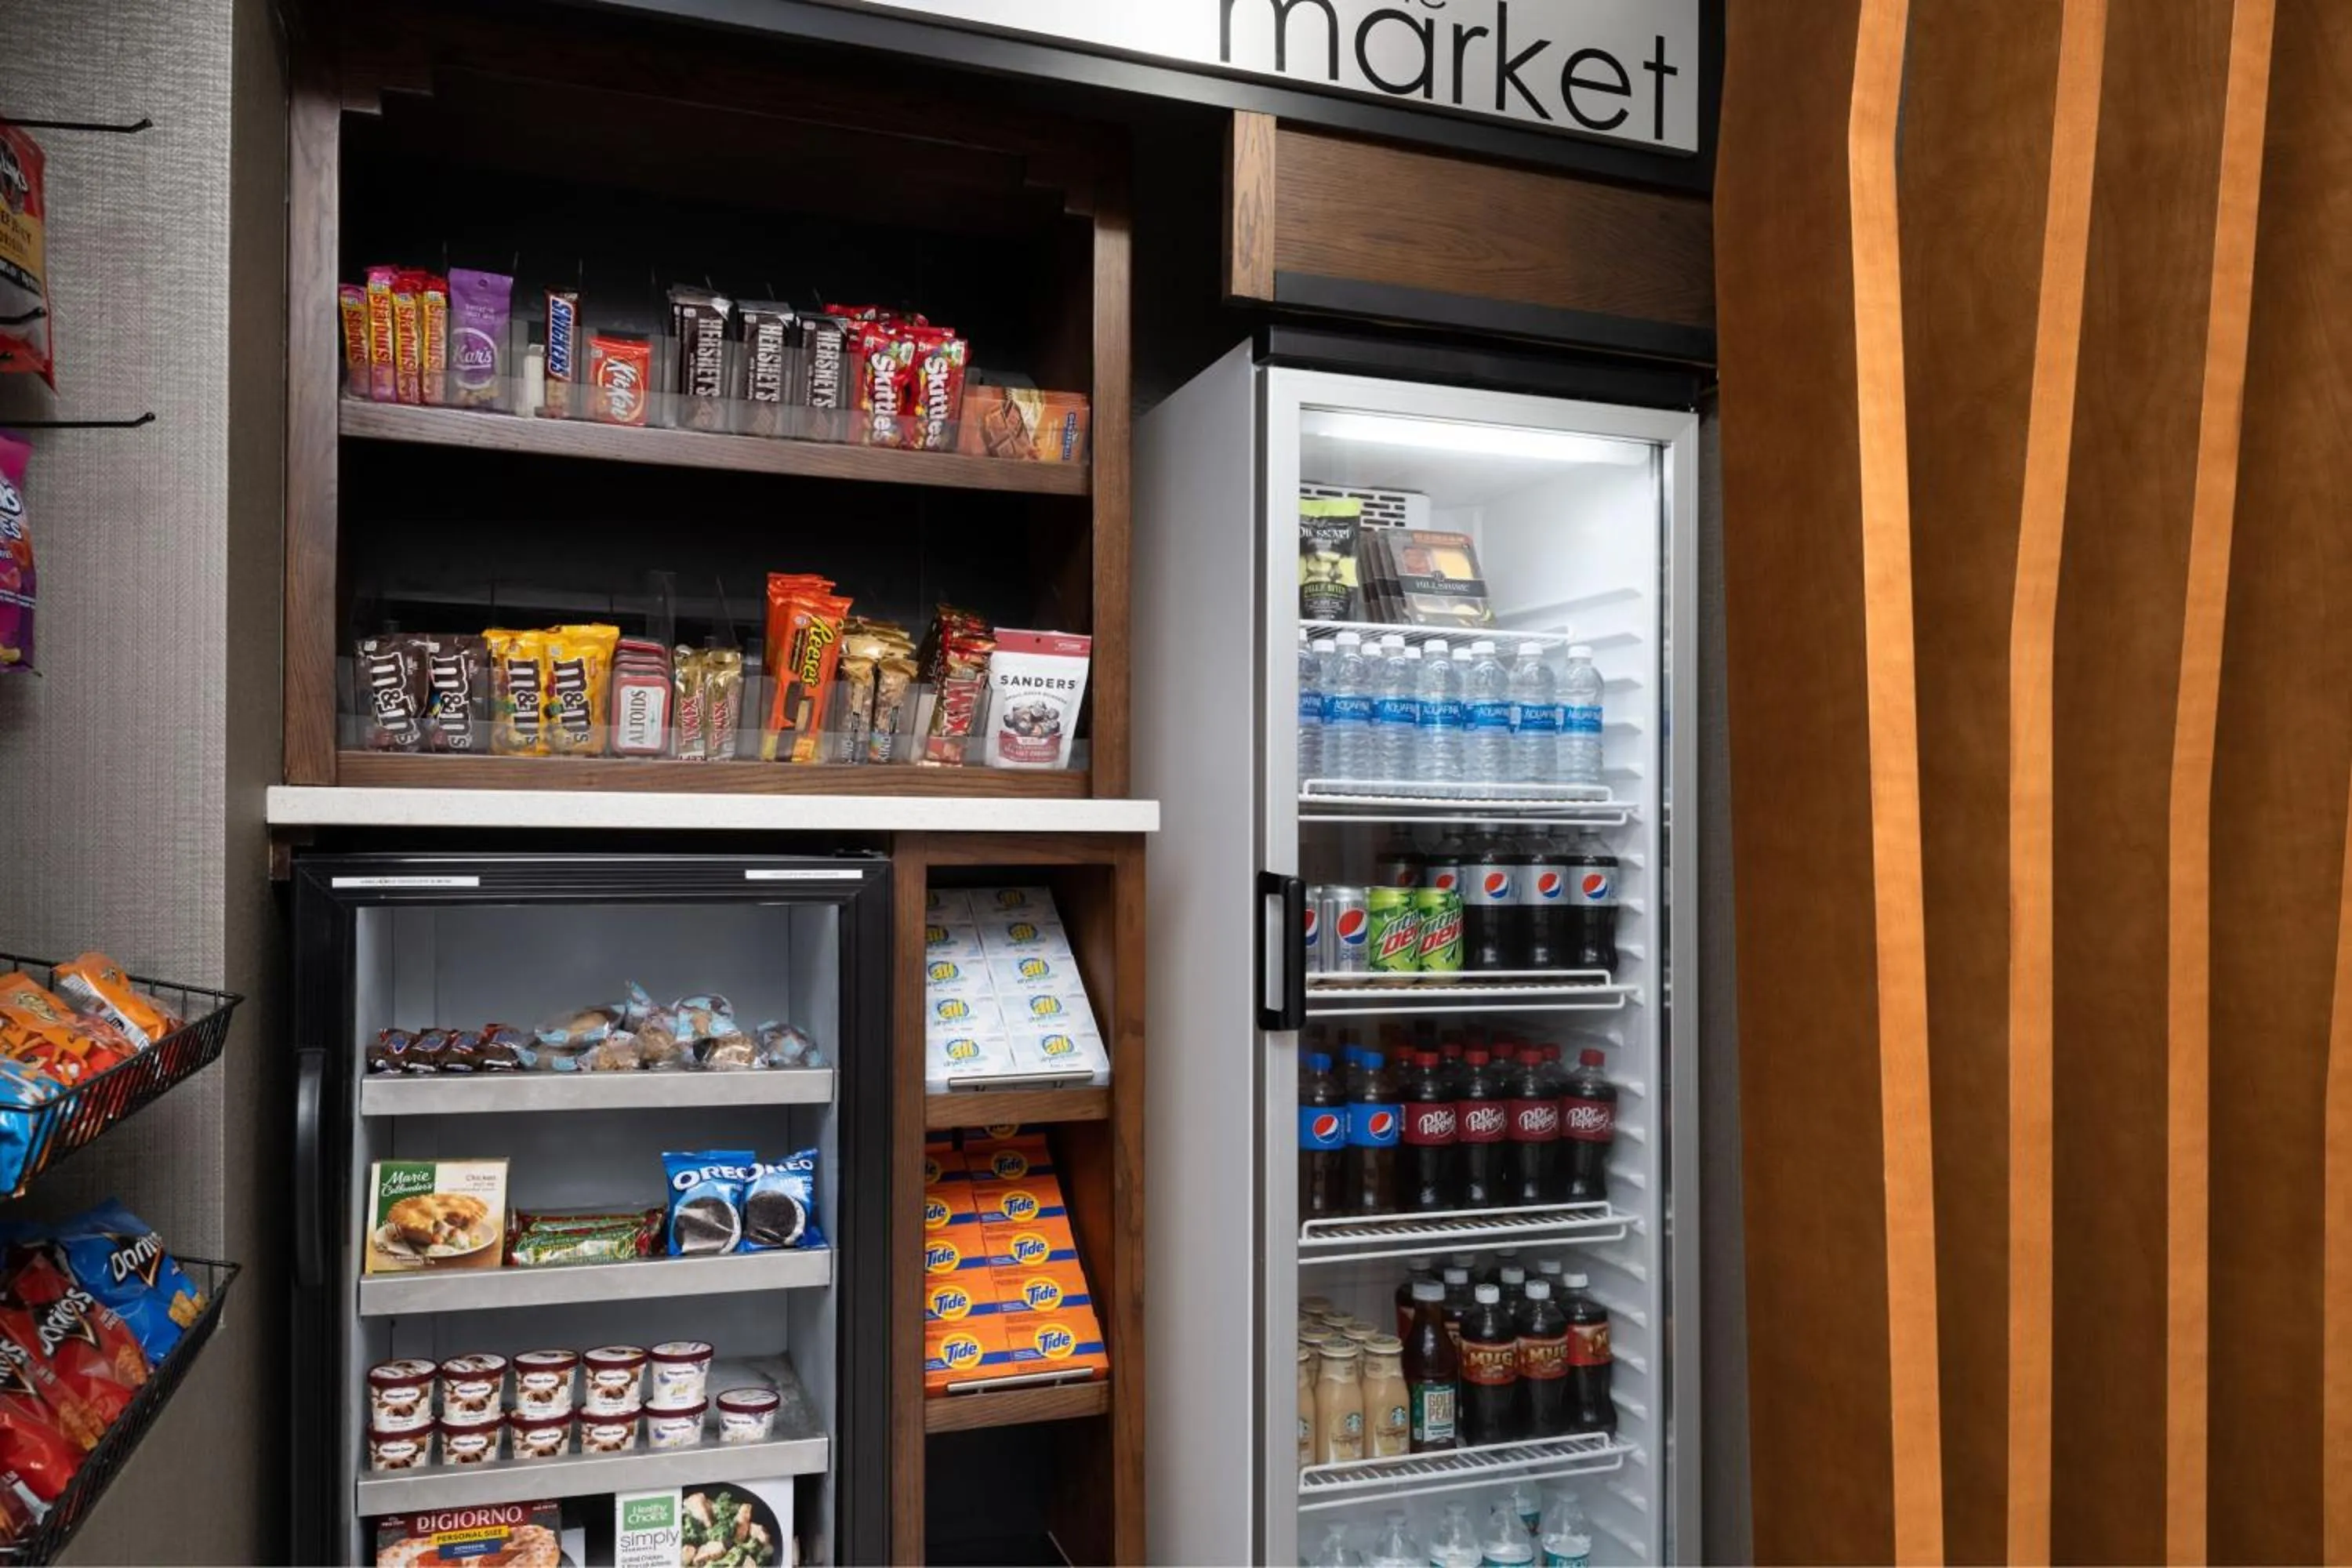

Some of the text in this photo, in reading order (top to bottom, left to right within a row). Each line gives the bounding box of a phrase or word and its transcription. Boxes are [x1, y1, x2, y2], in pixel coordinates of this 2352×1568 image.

[1219, 0, 1678, 140] market
[551, 297, 572, 378] SNICKERS
[696, 318, 723, 397] HERSHEY'S
[755, 324, 783, 402] HERSHEY'S
[813, 331, 841, 408] HERSHEY'S
[871, 353, 898, 442] Skittles
[925, 356, 948, 447] Skittles
[1000, 674, 1076, 690] SANDERS
[628, 690, 647, 744] ALTOIDS
[932, 962, 955, 981] all
[1022, 959, 1044, 978] all
[940, 1000, 965, 1019] all
[1033, 996, 1056, 1015] all
[952, 1040, 975, 1059] all
[1047, 1035, 1069, 1055] all
[383, 1171, 431, 1185] Marie
[926, 1204, 946, 1218] ide
[1004, 1198, 1034, 1216] Tide
[927, 1248, 955, 1268] Tide
[1013, 1240, 1045, 1260] Tide
[1025, 1285, 1058, 1305] Tide
[935, 1294, 967, 1317] Tide
[1038, 1333, 1071, 1354] Tide
[944, 1341, 978, 1367] Tide
[1470, 1351, 1513, 1367] MUG
[437, 1528, 503, 1542] PERSONAL SIZE
[620, 1530, 680, 1550] simply
